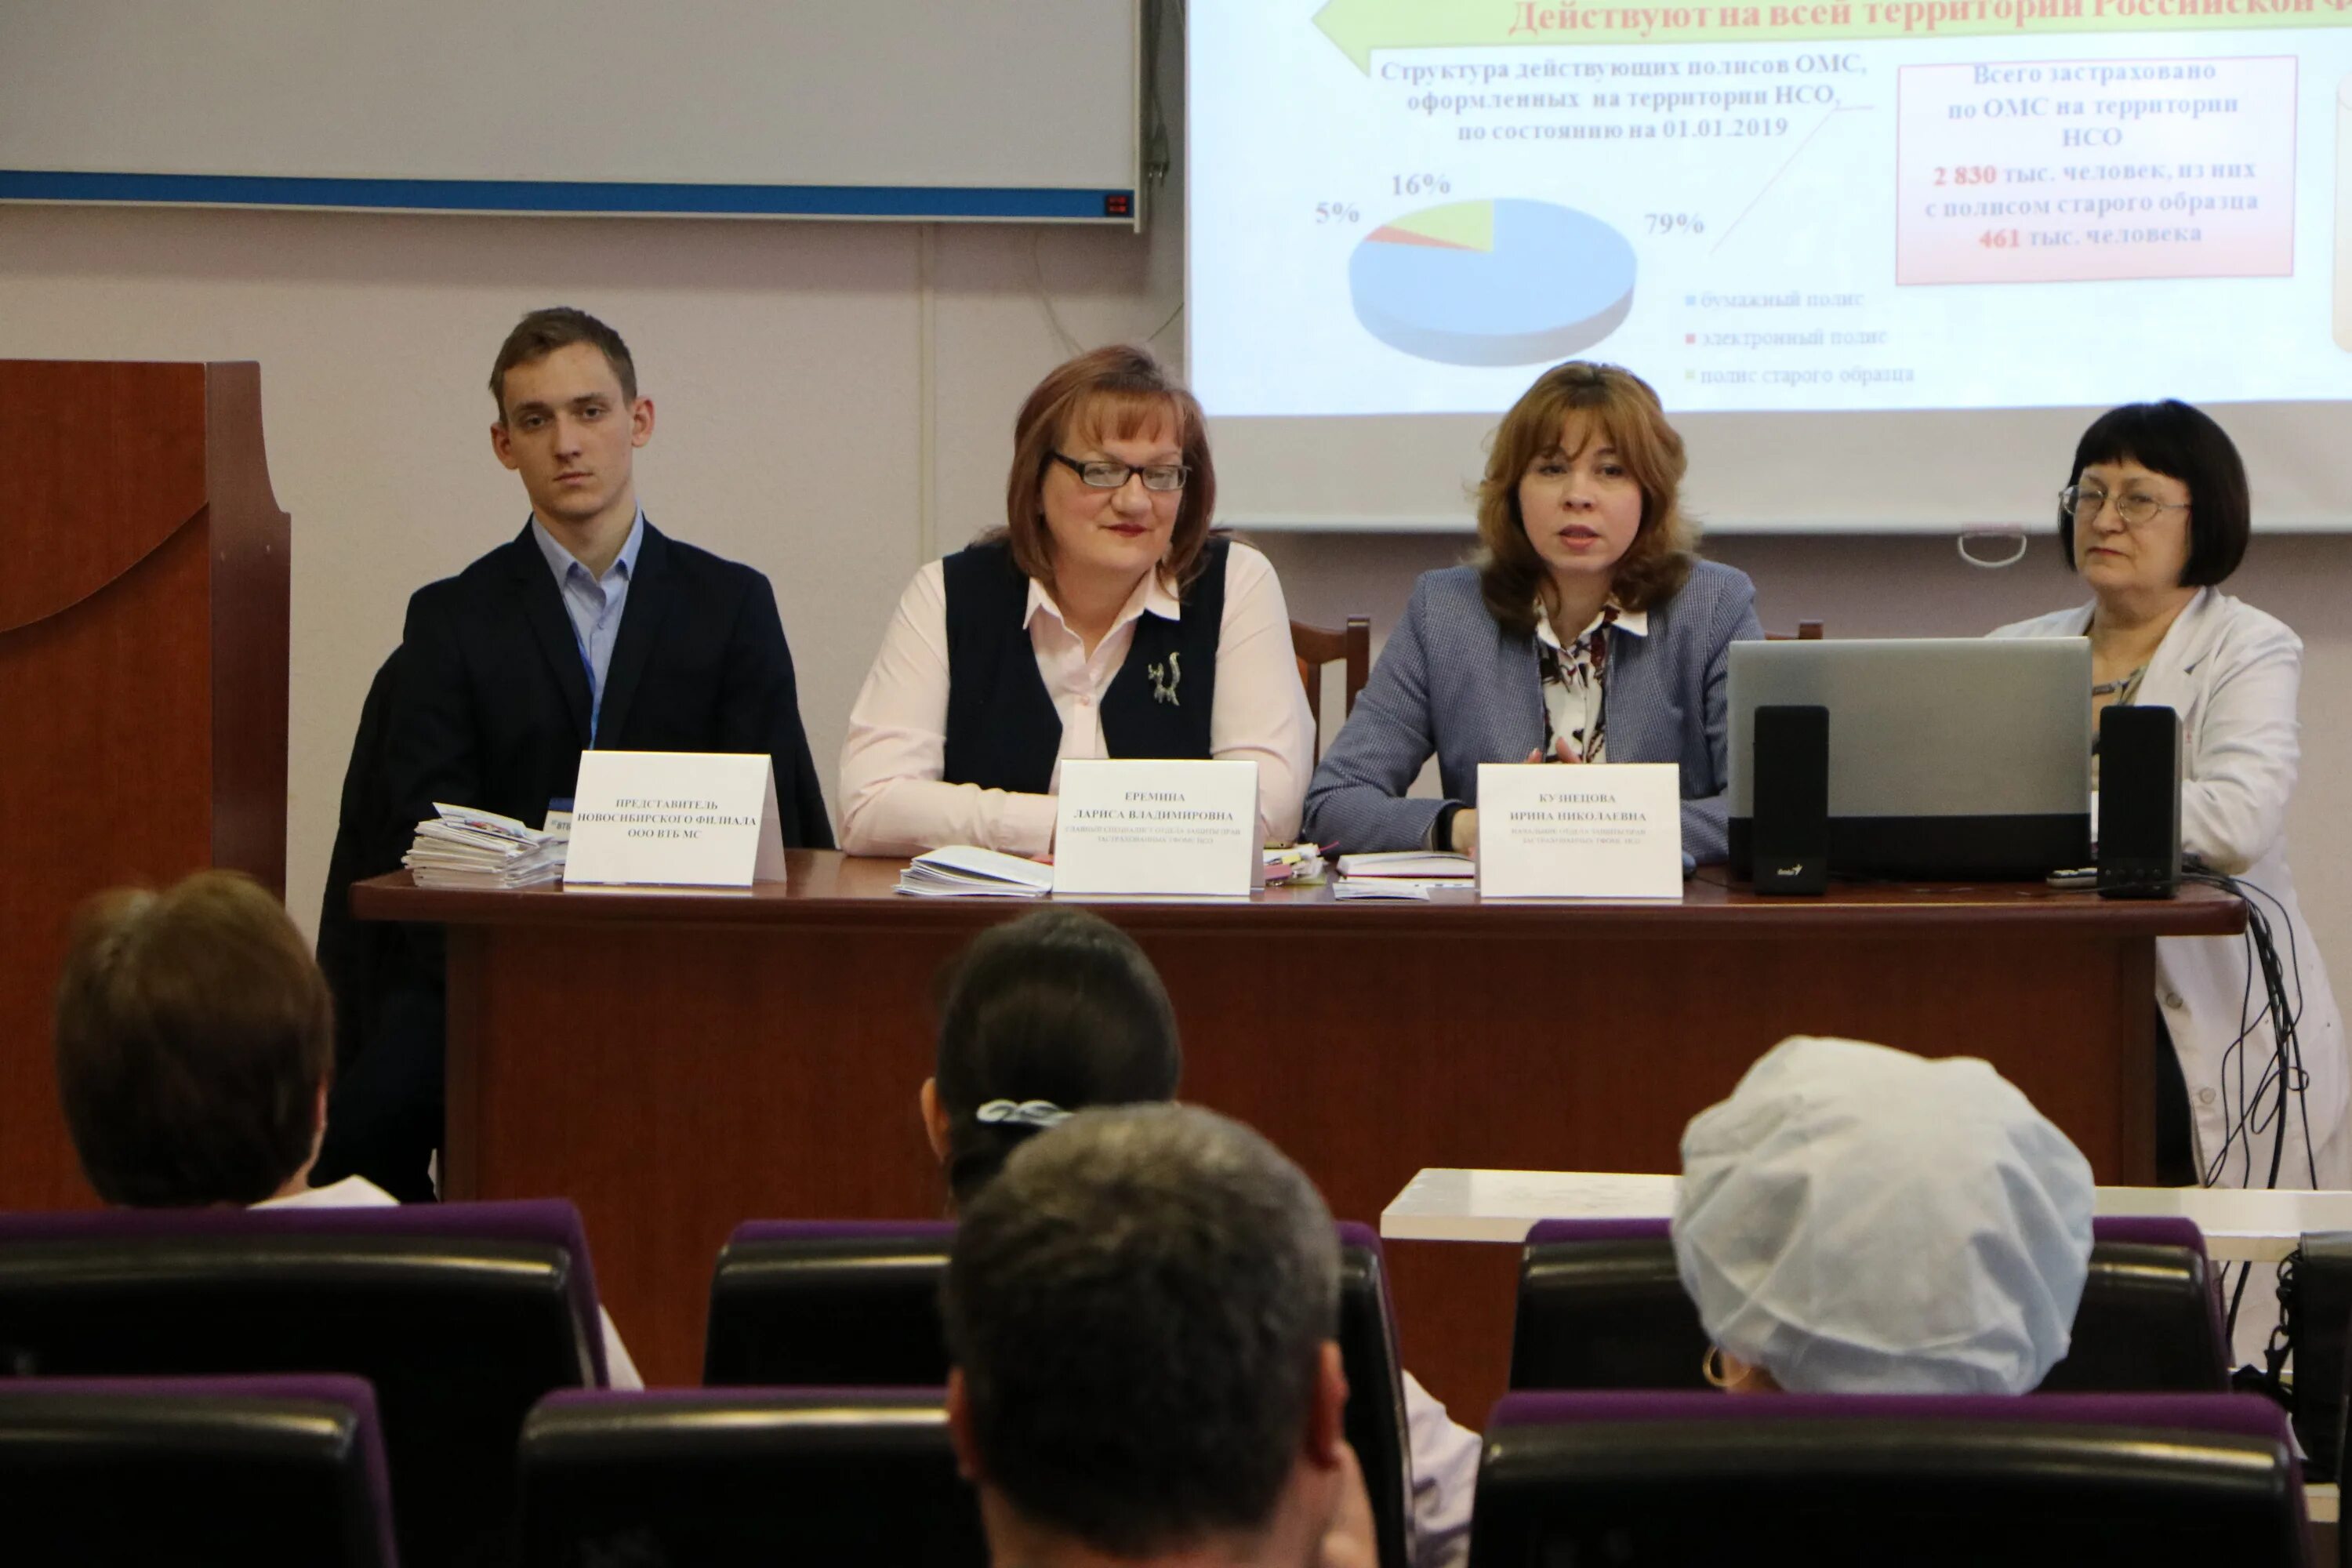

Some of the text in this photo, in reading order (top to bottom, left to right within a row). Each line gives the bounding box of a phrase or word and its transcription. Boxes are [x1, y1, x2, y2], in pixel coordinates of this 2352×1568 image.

[1508, 1, 1711, 38] Действуют
[1720, 6, 1760, 27] на
[1769, 0, 1852, 27] всей
[1863, 0, 2082, 31] территории
[1381, 53, 1867, 86] Структура действующих полисов ОМС,
[1973, 63, 2217, 86] Всего застраховано
[1407, 84, 1841, 115] оформленных на территории НСО,
[1947, 96, 2239, 120] по ОМС на территории
[1458, 116, 1789, 141] по состоянию на 01.01.2019
[2061, 126, 2124, 148] НСО
[1391, 173, 1451, 196] 16%
[1933, 161, 2257, 187] 2 830 тыс. человек, из них
[1316, 201, 1360, 224] 5%
[1925, 191, 2259, 218] с полисом старого образца
[1644, 212, 1706, 235] 79%
[1978, 226, 2203, 249] 461 тыс. человека
[1700, 290, 1865, 309] бумажный полис
[1702, 328, 1889, 350] электронный полис
[1700, 365, 1915, 387] полис старого образца
[615, 798, 718, 811] ПРЕДСТАВИТЕЛЬ
[1125, 792, 1186, 802] ЕРЕМИНА
[1539, 793, 1616, 804] КУЗНЕЦОВА
[577, 812, 757, 826] НОВОСИБИРСКОГО ФИЛИАЛА
[1073, 809, 1234, 822] ЛАРИСА ВЛАДИМИРОВНА
[1510, 811, 1647, 822] ИРИНА НИКОЛАЕВНА
[627, 829, 702, 839] ООО ВТБ МС
